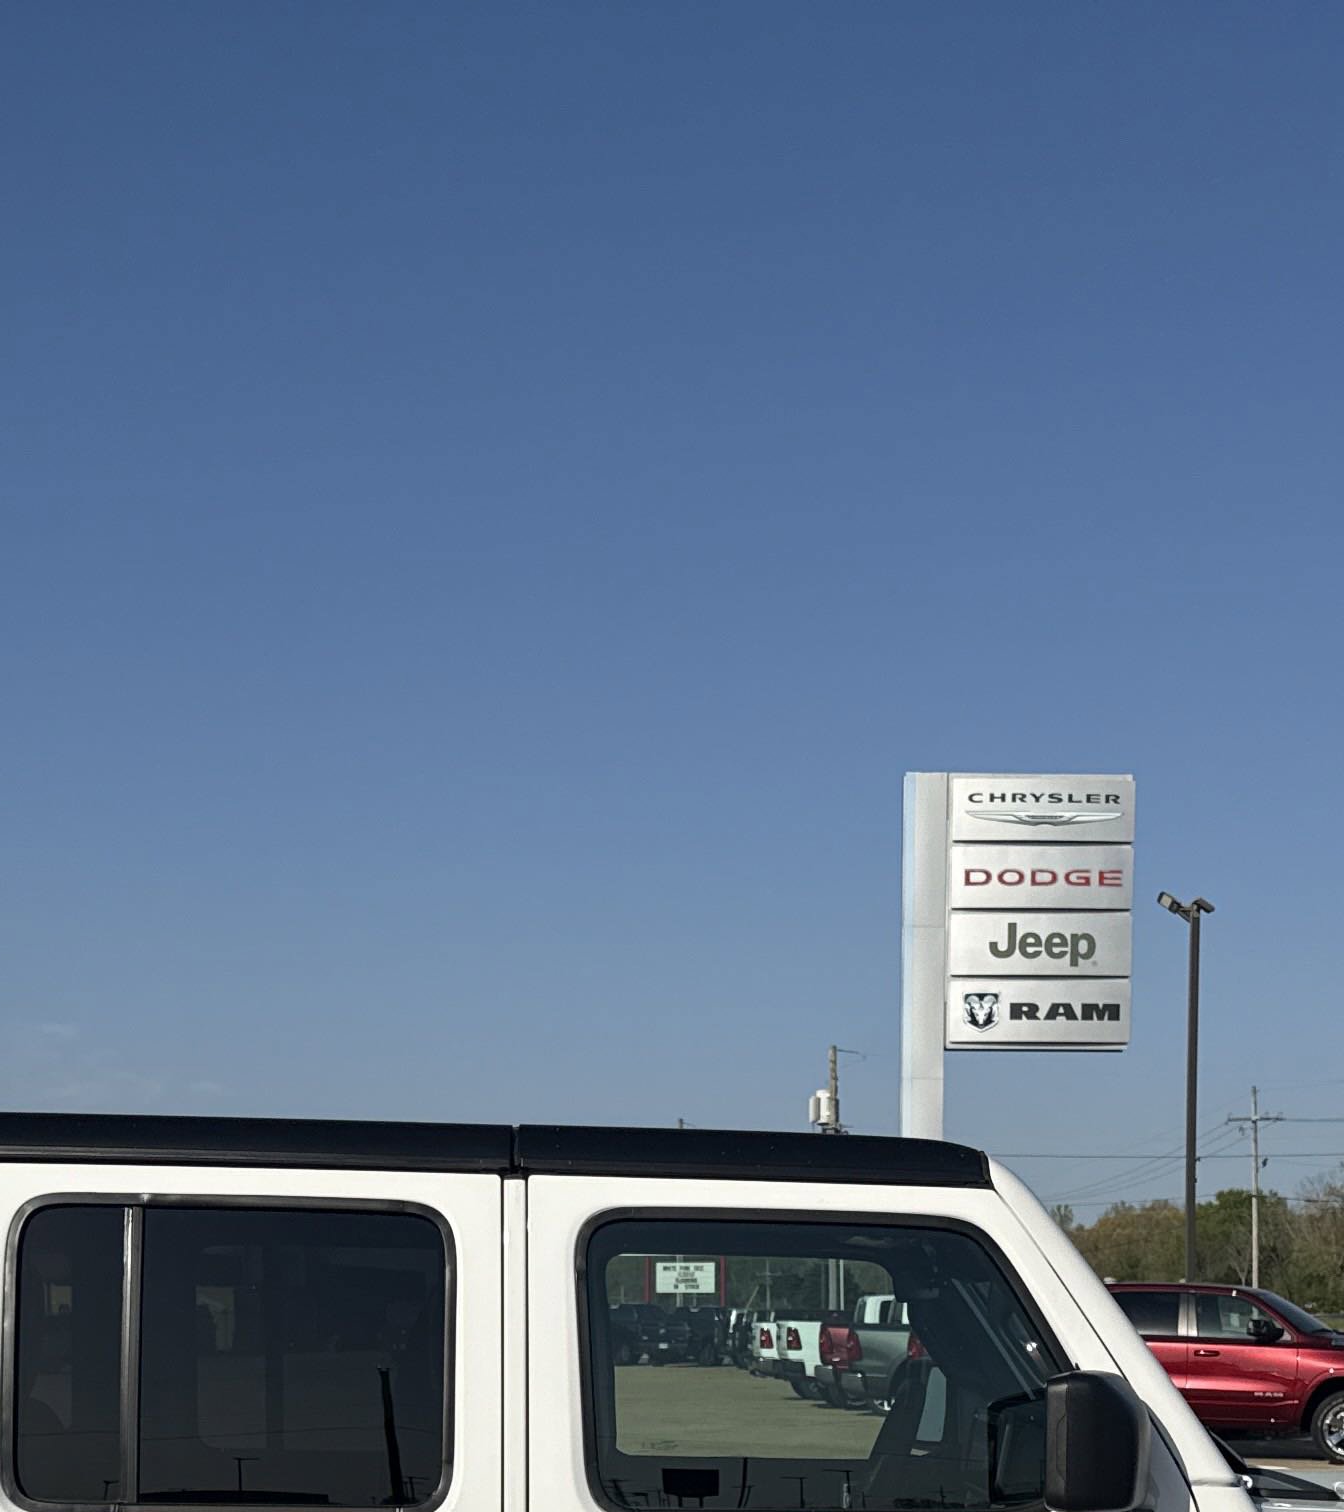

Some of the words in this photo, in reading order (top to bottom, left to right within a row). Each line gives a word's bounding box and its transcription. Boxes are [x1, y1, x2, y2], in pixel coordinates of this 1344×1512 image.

[967, 792, 1121, 805] CHRYSLER
[963, 868, 1124, 887] DODGE
[988, 922, 1097, 968] Jeep
[1009, 1002, 1121, 1021] RAM
